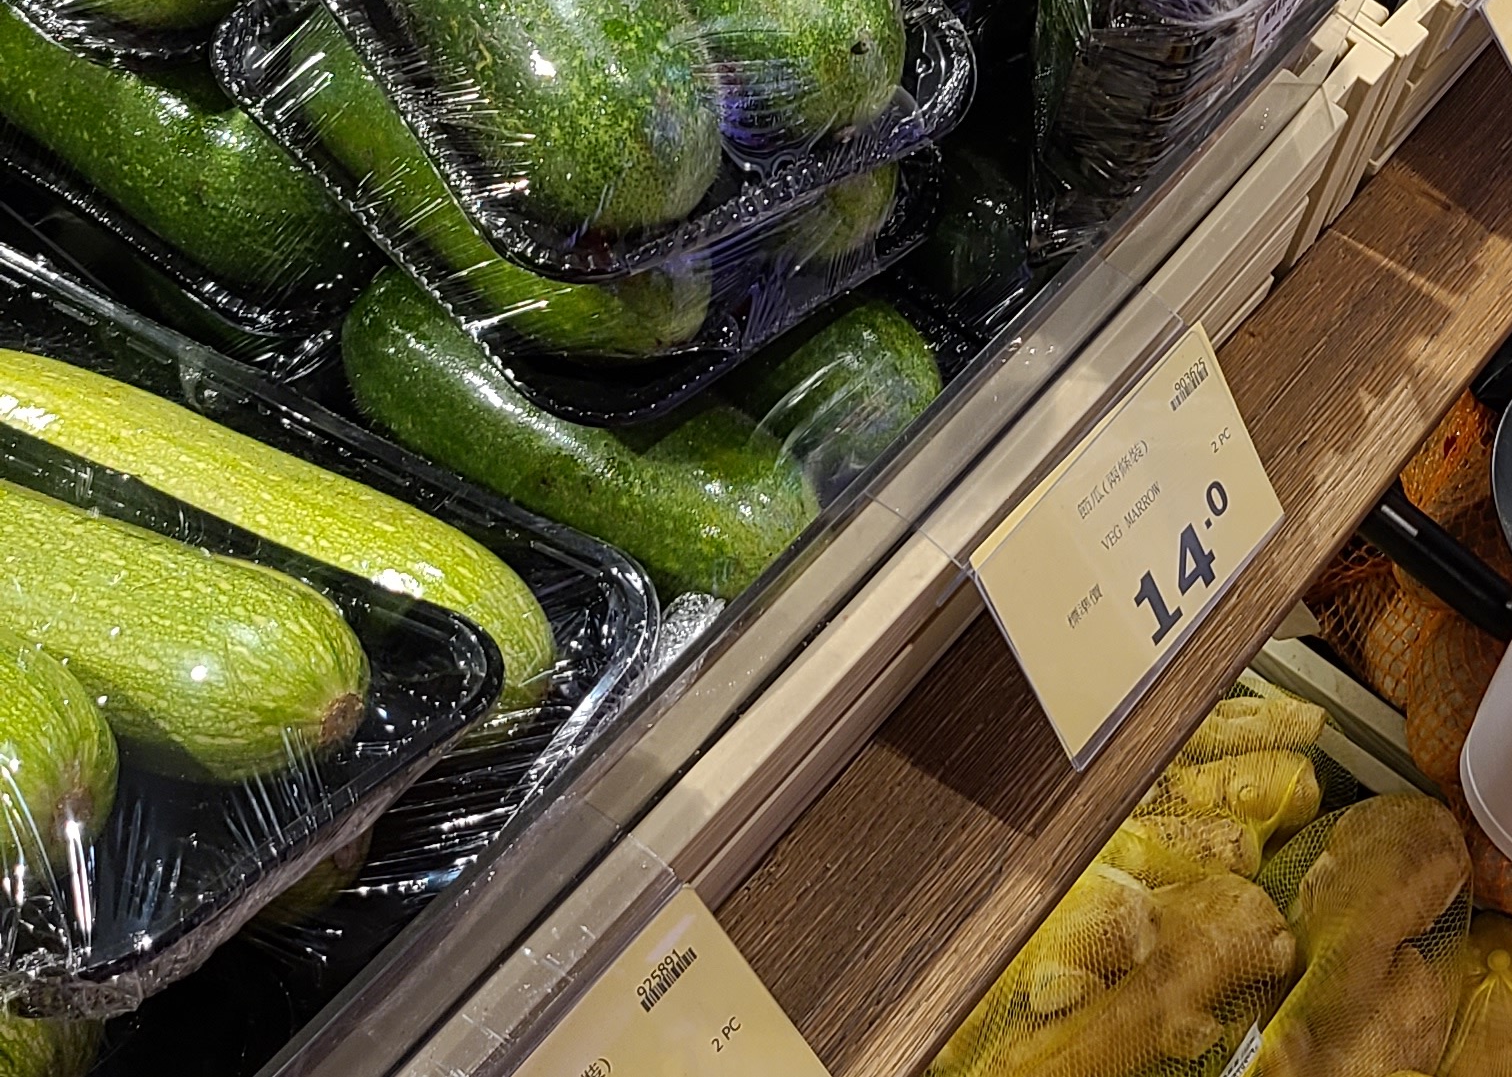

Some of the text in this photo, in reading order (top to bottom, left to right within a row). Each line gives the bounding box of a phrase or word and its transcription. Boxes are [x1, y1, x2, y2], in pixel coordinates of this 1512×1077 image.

[1174, 357, 1206, 392] 903625
[1209, 427, 1232, 454] 2 PC
[1100, 481, 1162, 552] VEG MARROW
[1133, 480, 1229, 646] 14.0
[636, 948, 682, 998] 925891
[711, 1016, 742, 1053] 2 PC
